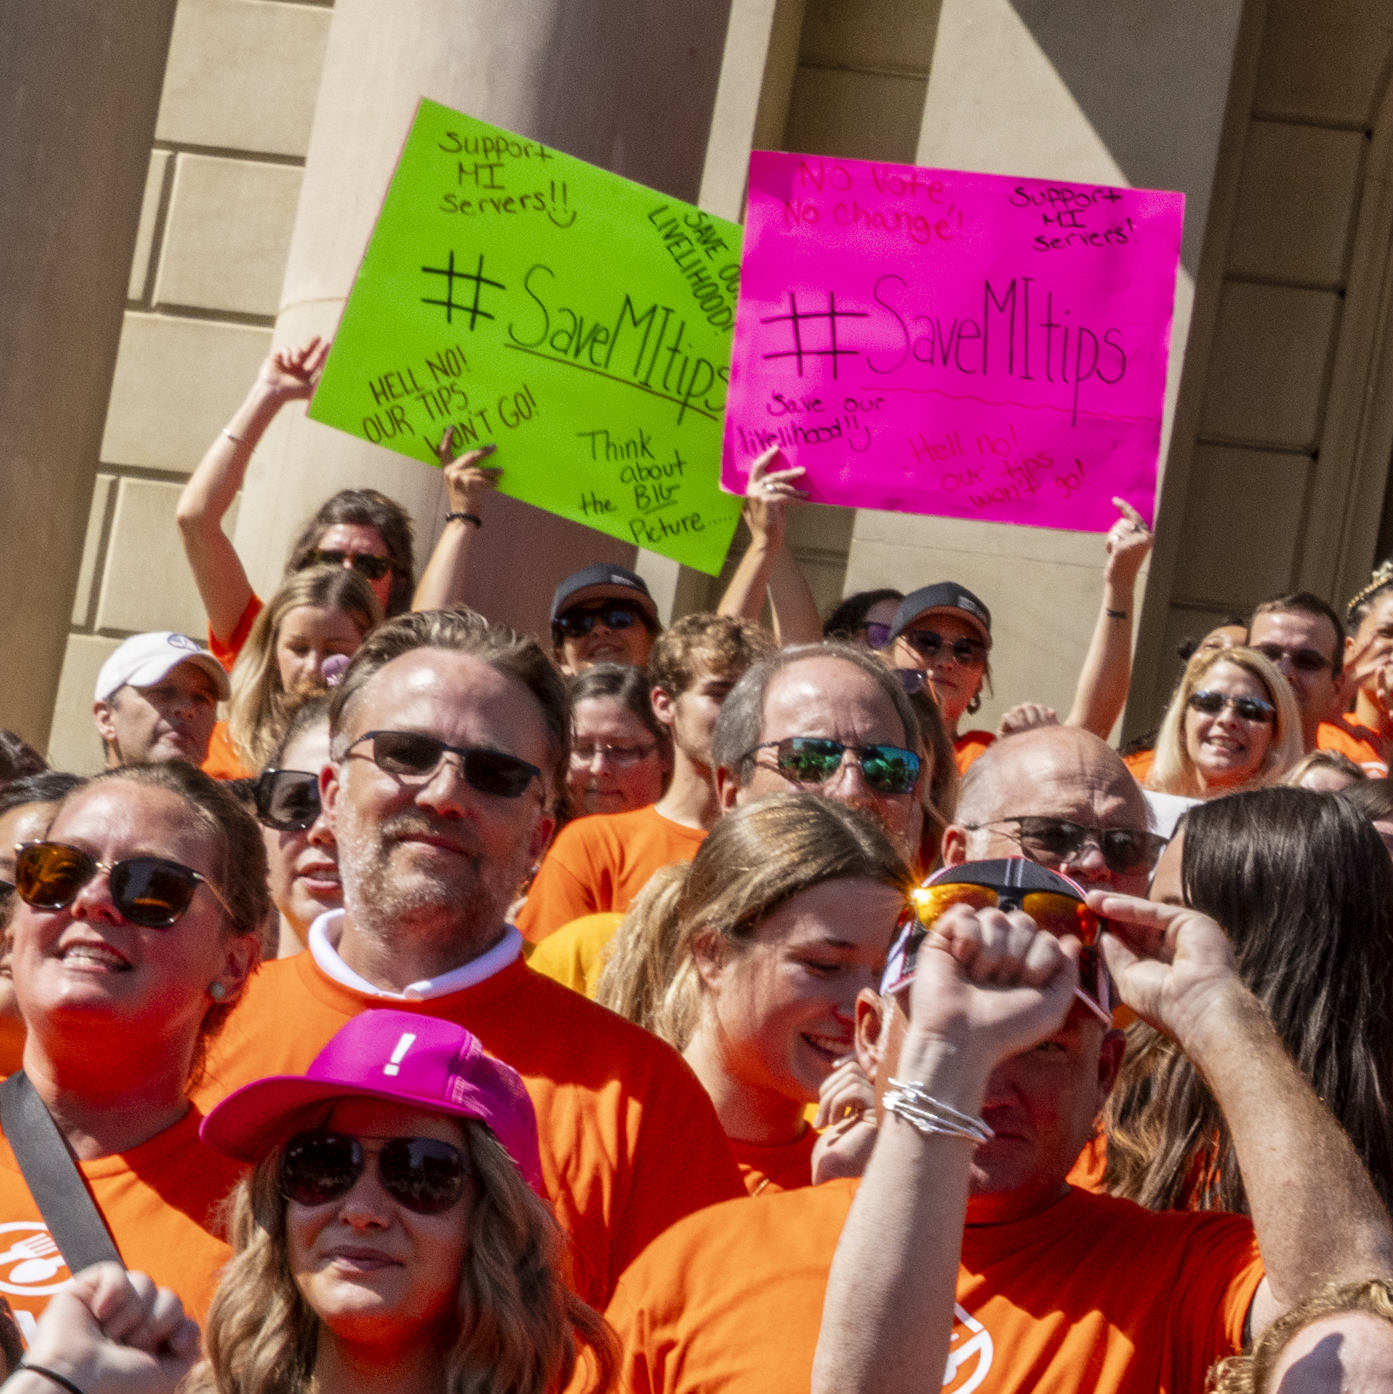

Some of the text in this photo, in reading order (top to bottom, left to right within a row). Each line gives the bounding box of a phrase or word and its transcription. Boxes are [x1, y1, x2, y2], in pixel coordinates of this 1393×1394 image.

[439, 130, 553, 164] Support
[457, 161, 506, 190] MI
[683, 211, 730, 261] SAVE
[1042, 208, 1087, 230] MI
[368, 345, 471, 406] HELL NO!
[497, 383, 540, 429] GO!
[844, 397, 886, 413] our
[362, 404, 415, 444] OUR
[577, 428, 656, 462] Think
[620, 449, 687, 484] about
[578, 484, 681, 517] the BIG
